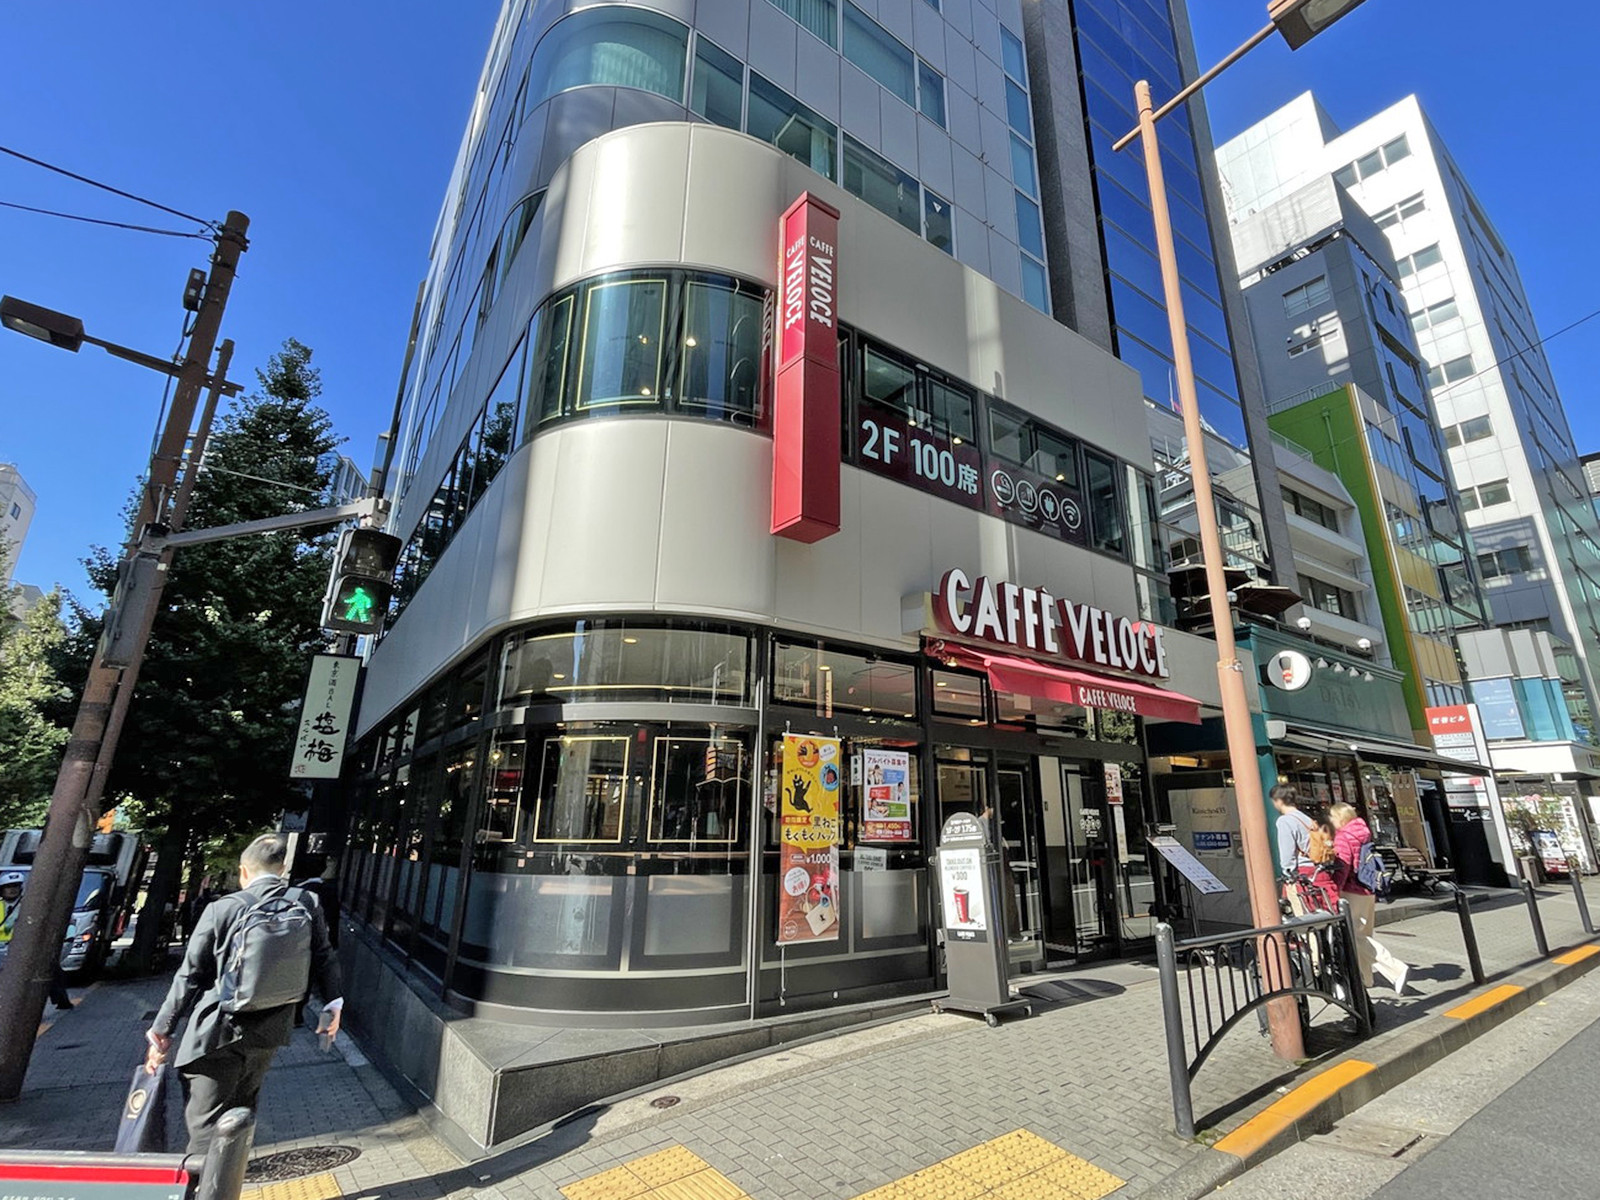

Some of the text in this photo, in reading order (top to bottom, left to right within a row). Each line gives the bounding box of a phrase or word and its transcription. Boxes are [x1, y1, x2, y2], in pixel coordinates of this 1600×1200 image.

[785, 250, 804, 330] VELOCE
[810, 255, 833, 329] VELOCE
[862, 419, 978, 495] 2F 100席
[1062, 598, 1170, 678] VELOCE
[1106, 691, 1137, 713] VELOCE
[867, 756, 907, 766] アルバイト募集中
